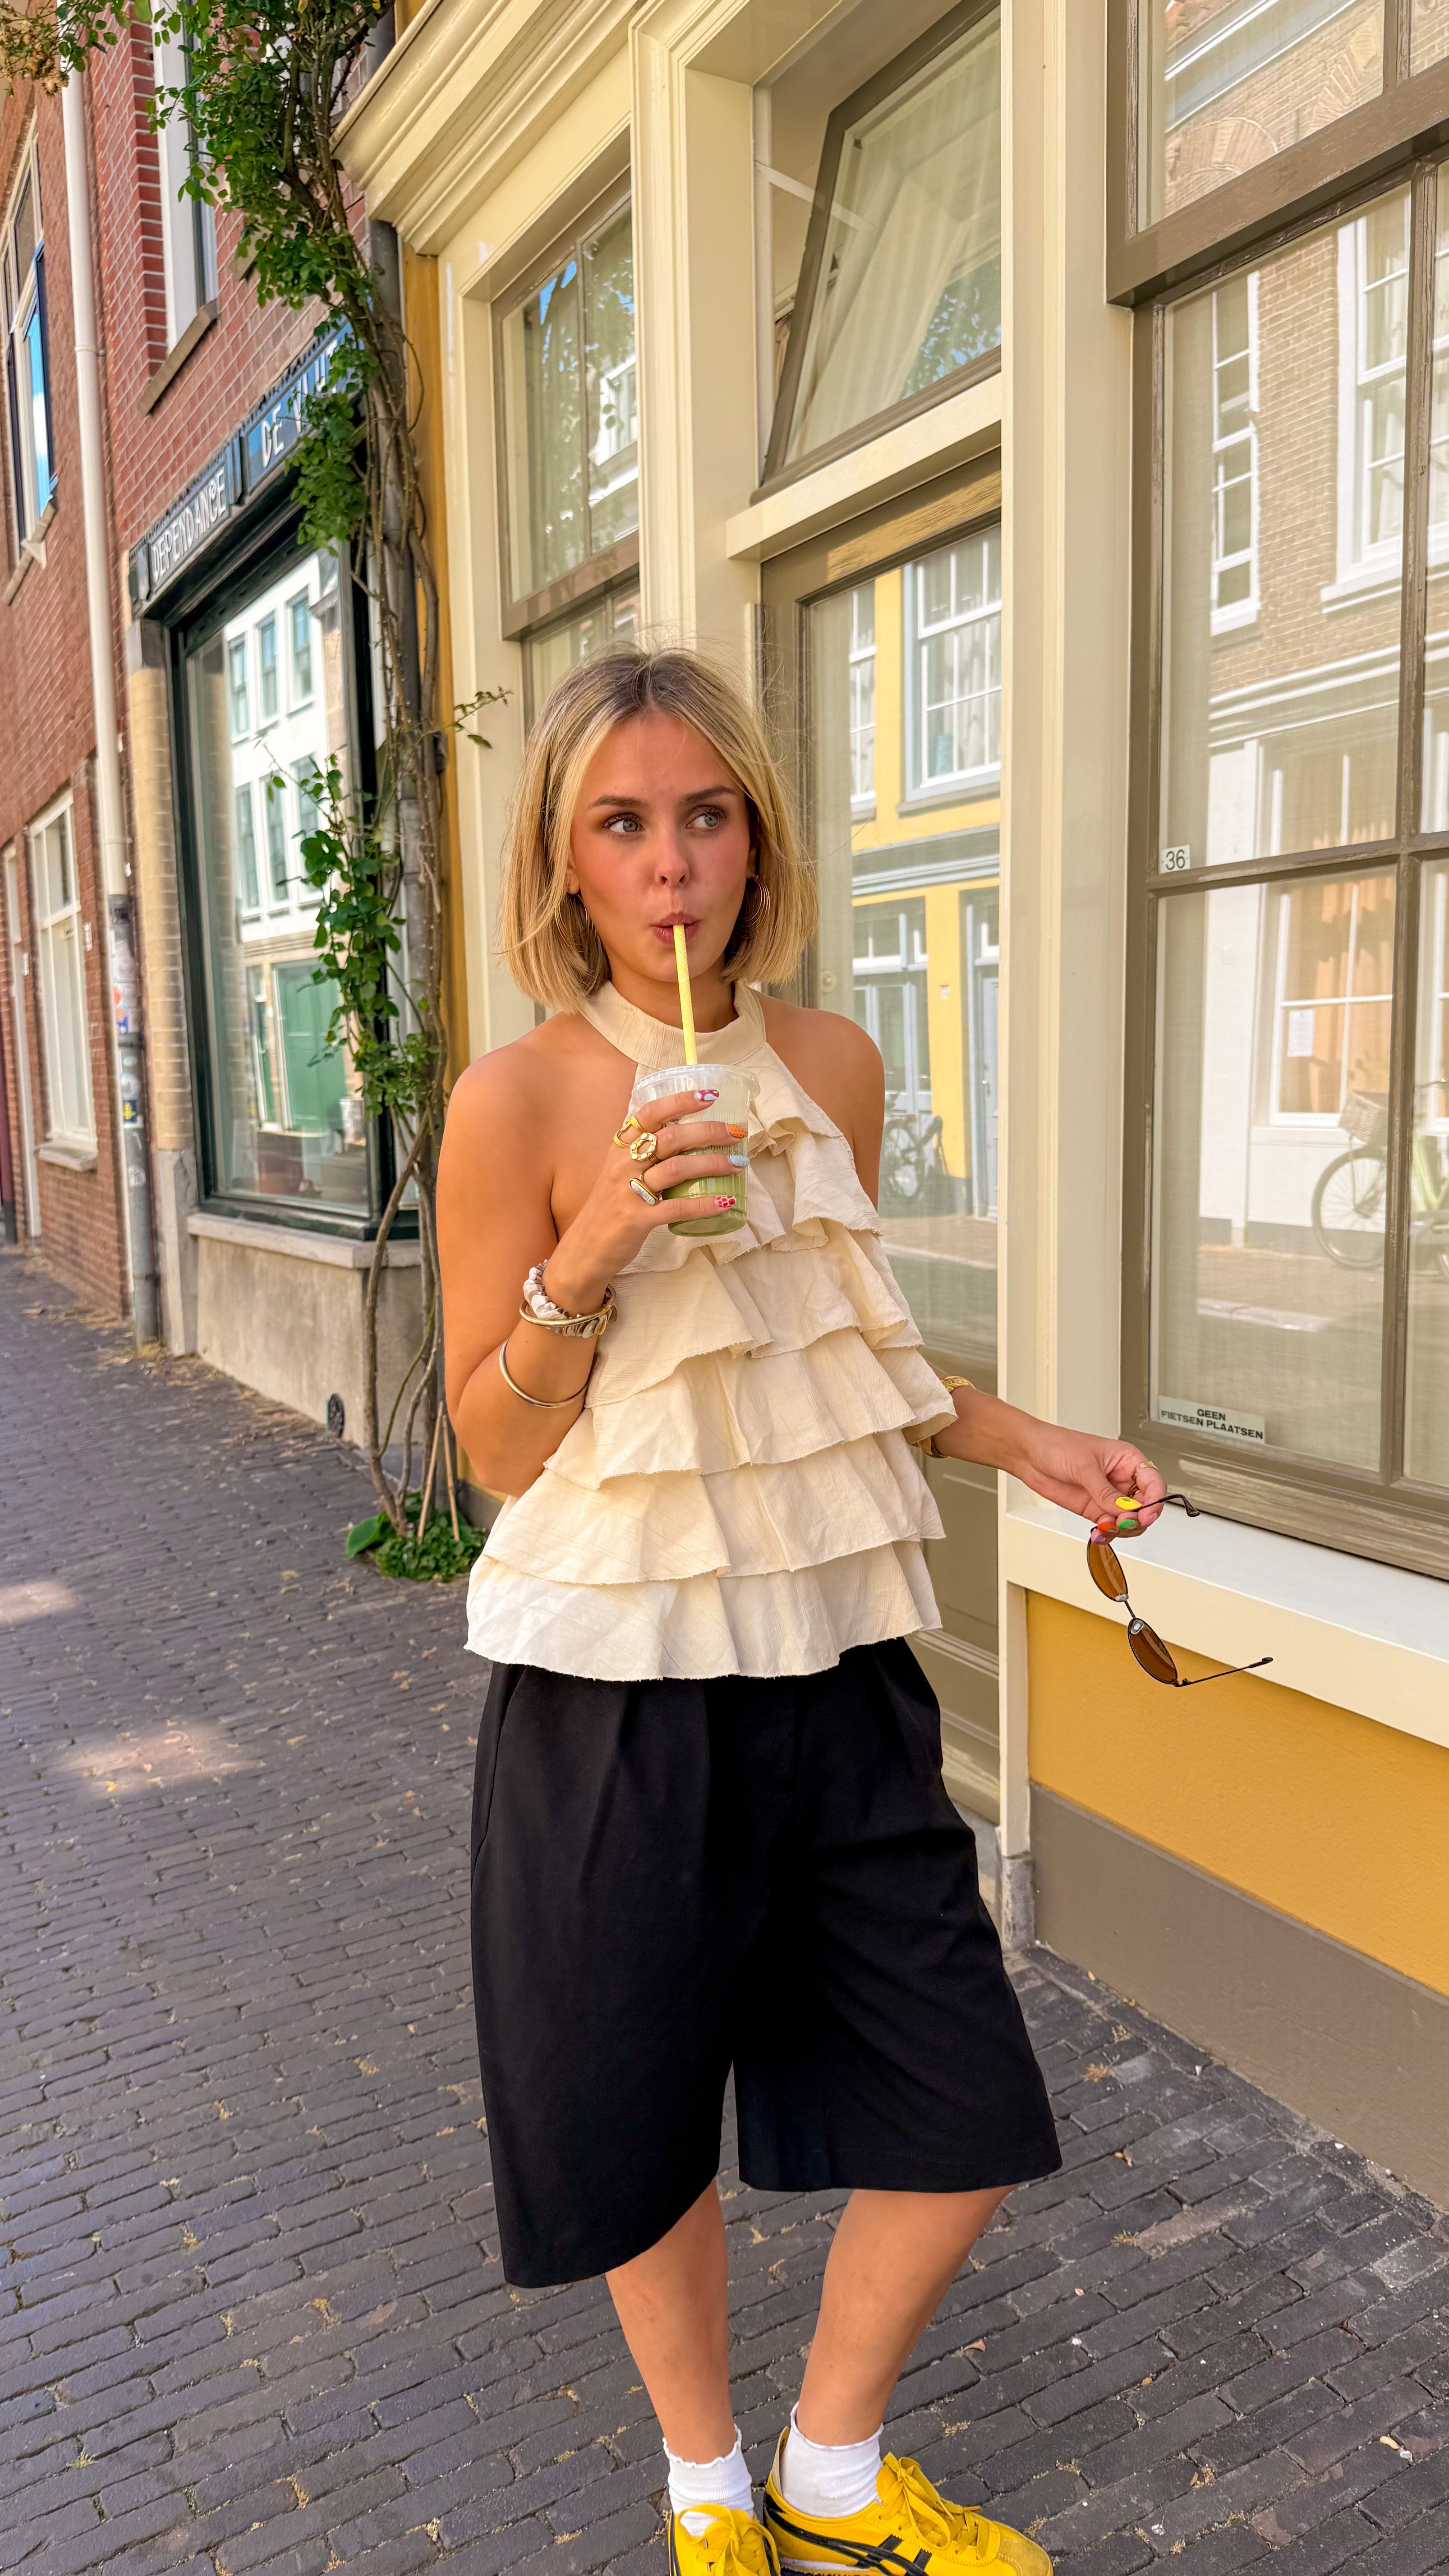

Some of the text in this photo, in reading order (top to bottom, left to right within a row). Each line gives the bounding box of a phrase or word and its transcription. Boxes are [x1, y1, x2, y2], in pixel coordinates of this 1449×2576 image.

[152, 466, 226, 583] DEPENDANCE
[261, 404, 284, 468] DE
[1166, 849, 1185, 870] 36
[1161, 1410, 1263, 1440] FIETSEN PLAATSEN
[1197, 1408, 1226, 1421] GEEN
